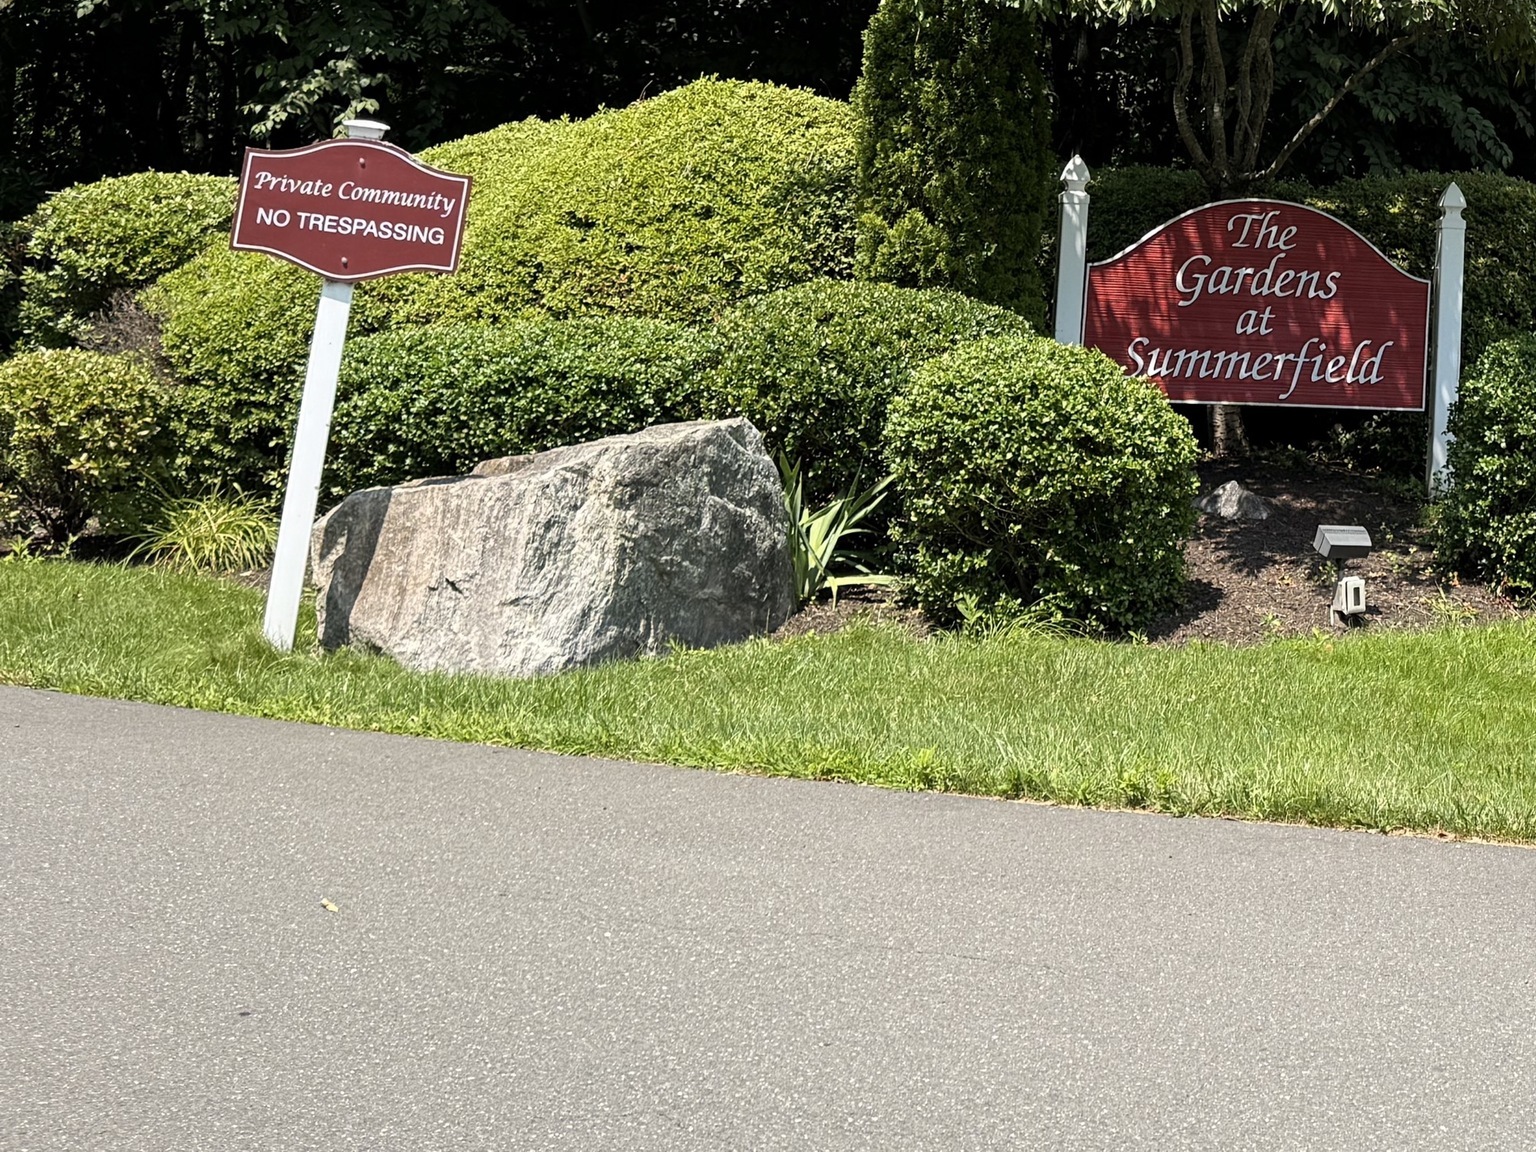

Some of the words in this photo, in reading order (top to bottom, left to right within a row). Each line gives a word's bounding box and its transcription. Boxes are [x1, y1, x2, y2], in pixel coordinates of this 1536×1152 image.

[254, 171, 332, 197] Private
[338, 182, 455, 217] Community
[256, 207, 290, 227] NO
[297, 212, 445, 245] TRESPASSING
[1227, 210, 1298, 250] The
[1175, 252, 1342, 307] Gardens
[1235, 305, 1276, 336] at
[1124, 337, 1394, 400] Summerfield
